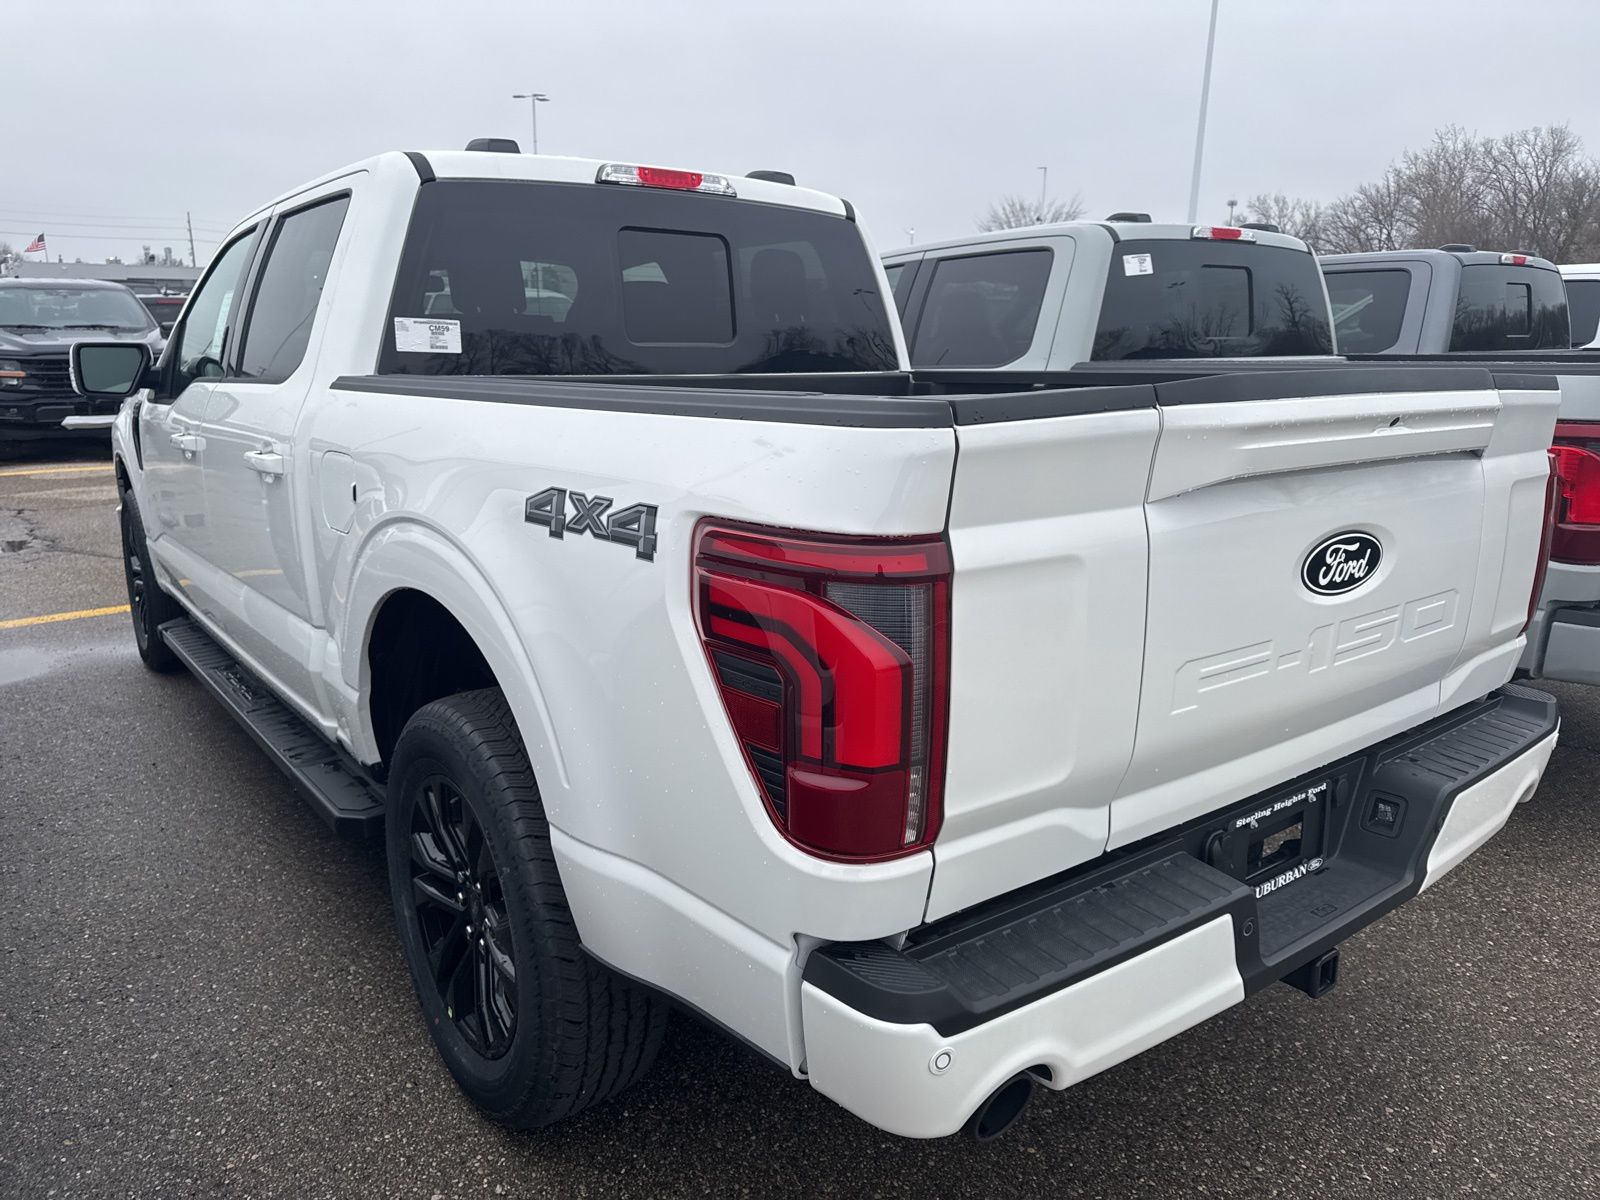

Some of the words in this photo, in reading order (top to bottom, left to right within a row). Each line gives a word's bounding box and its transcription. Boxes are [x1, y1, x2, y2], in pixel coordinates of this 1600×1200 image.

[1318, 542, 1371, 586] Ford
[1171, 588, 1459, 715] F-150
[1236, 807, 1272, 828] Sterling
[1273, 793, 1306, 811] Heights
[1307, 783, 1326, 797] Ford
[1254, 864, 1307, 898] UBURBAN
